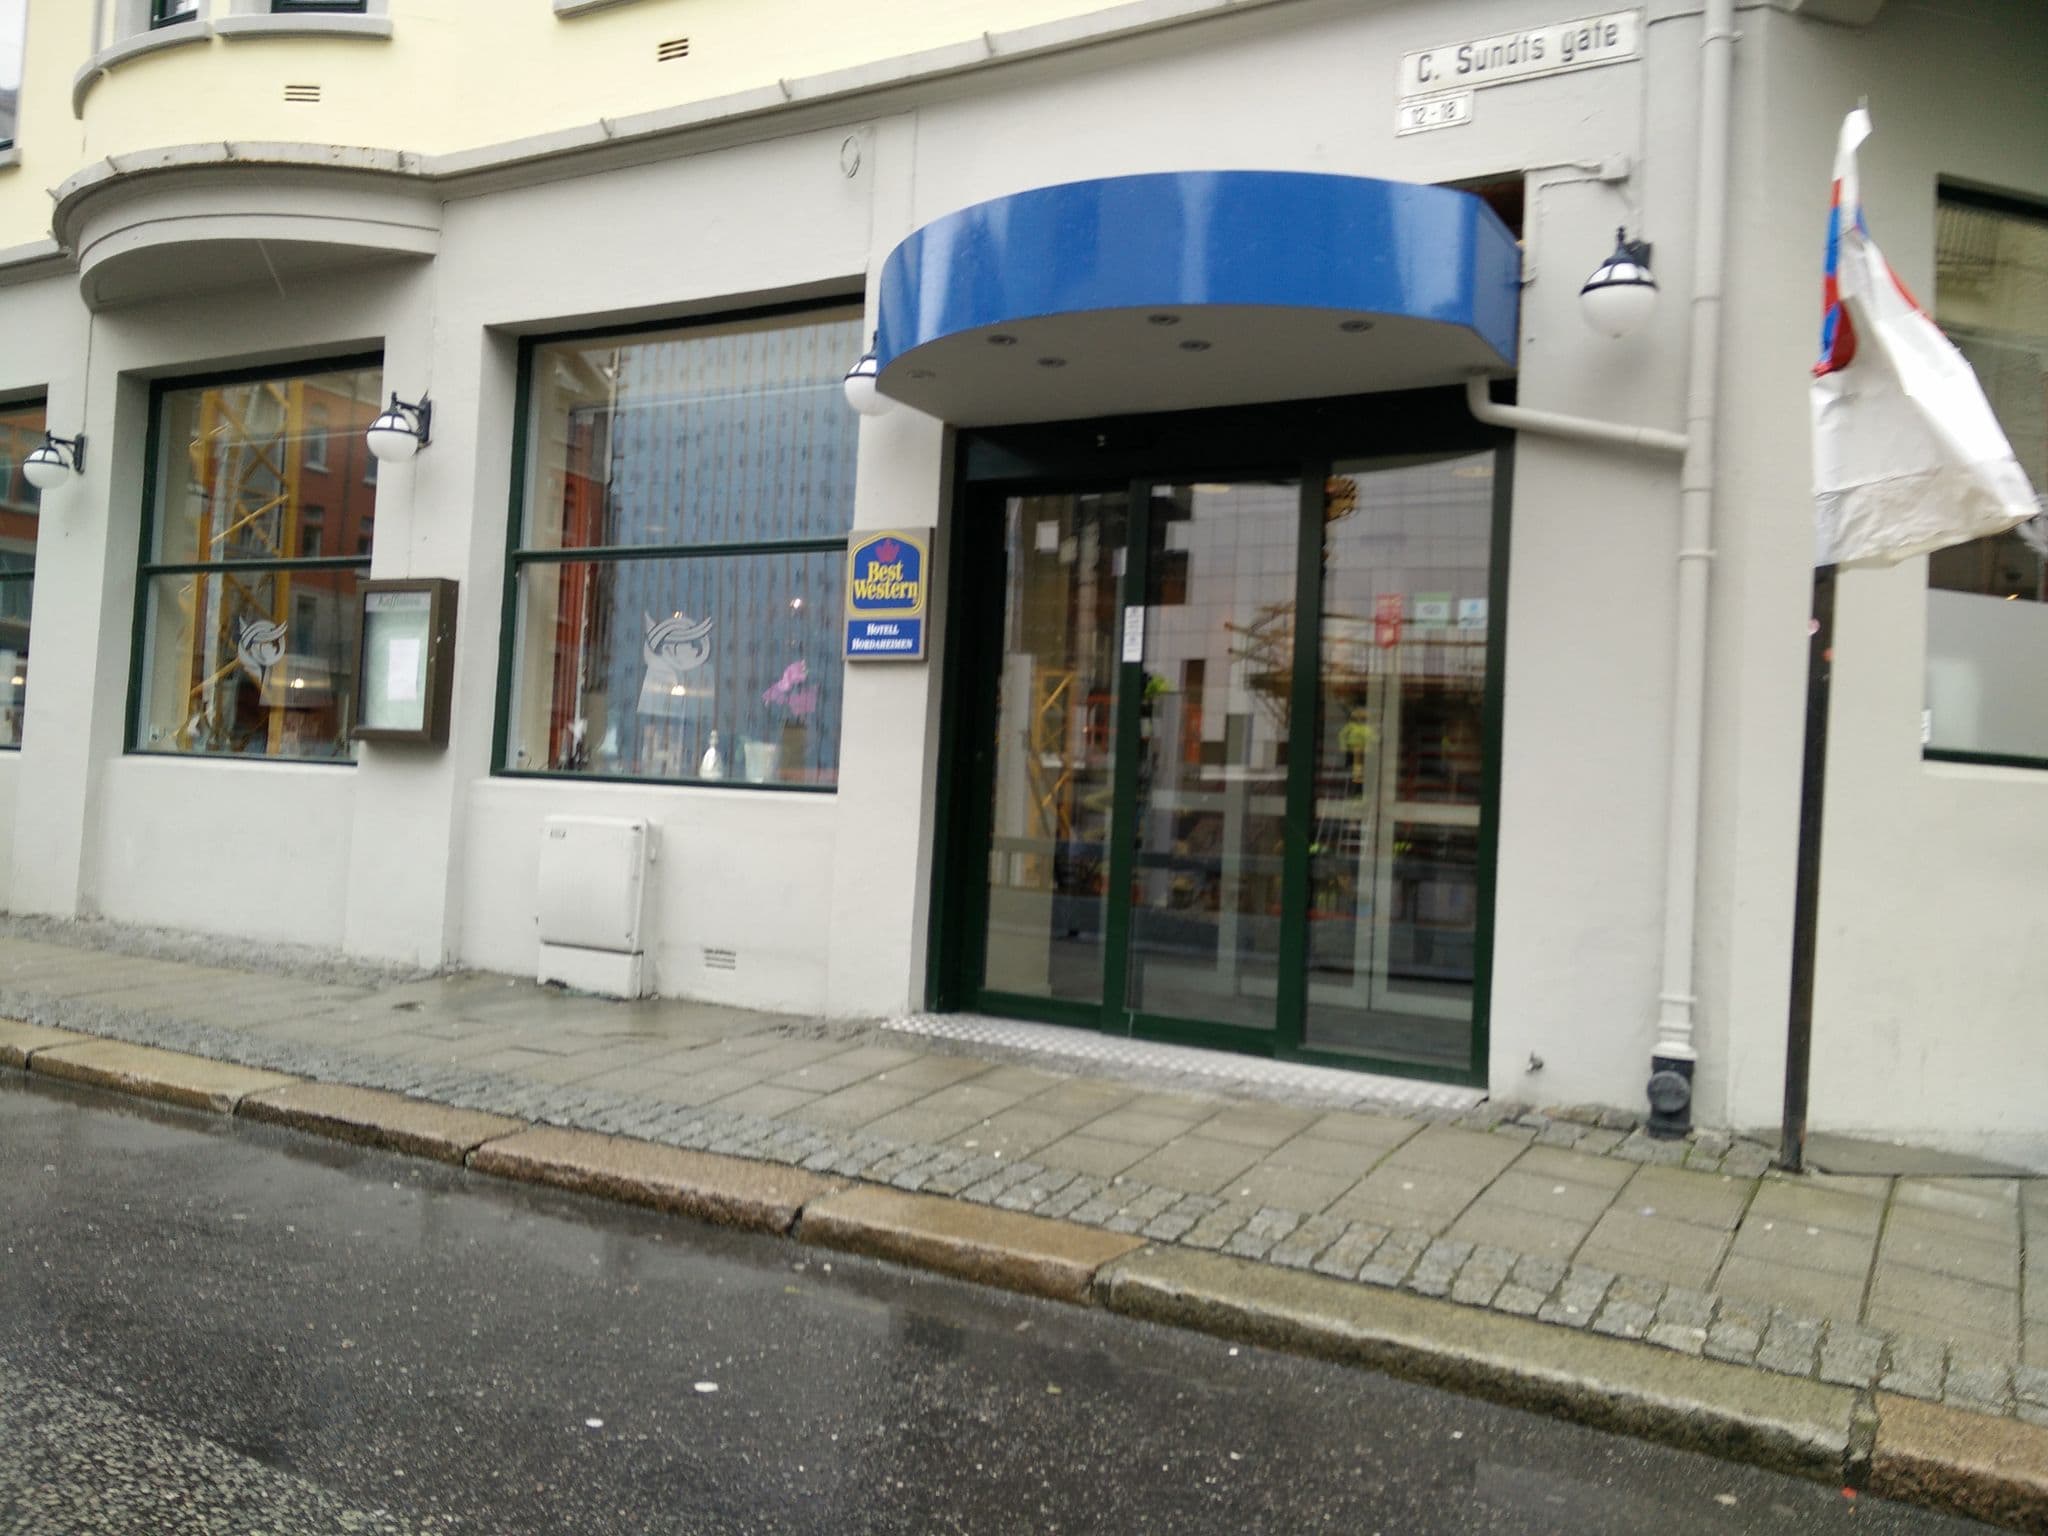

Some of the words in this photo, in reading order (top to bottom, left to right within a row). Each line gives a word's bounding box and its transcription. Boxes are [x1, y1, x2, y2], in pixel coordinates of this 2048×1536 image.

[1418, 54, 1440, 83] C.
[1457, 35, 1546, 75] Sundts
[1561, 21, 1618, 63] gate
[867, 560, 903, 581] Best
[854, 578, 918, 604] Western
